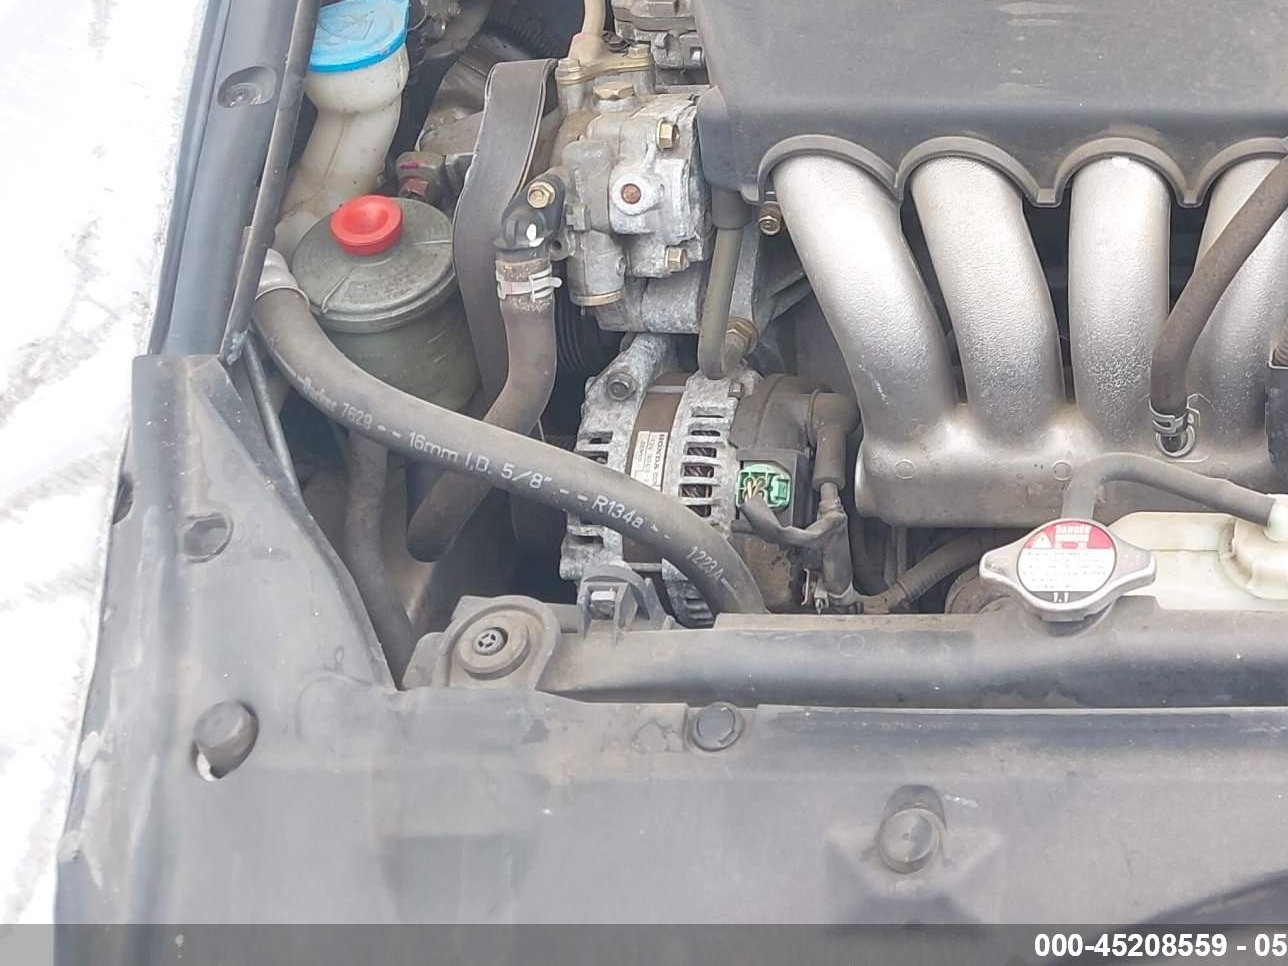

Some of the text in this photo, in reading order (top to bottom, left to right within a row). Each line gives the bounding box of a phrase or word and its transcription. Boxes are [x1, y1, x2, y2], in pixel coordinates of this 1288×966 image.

[654, 434, 665, 470] HONDA
[408, 430, 459, 463] 16mm
[592, 495, 645, 530] R134a
[1053, 592, 1070, 603] 1.1
